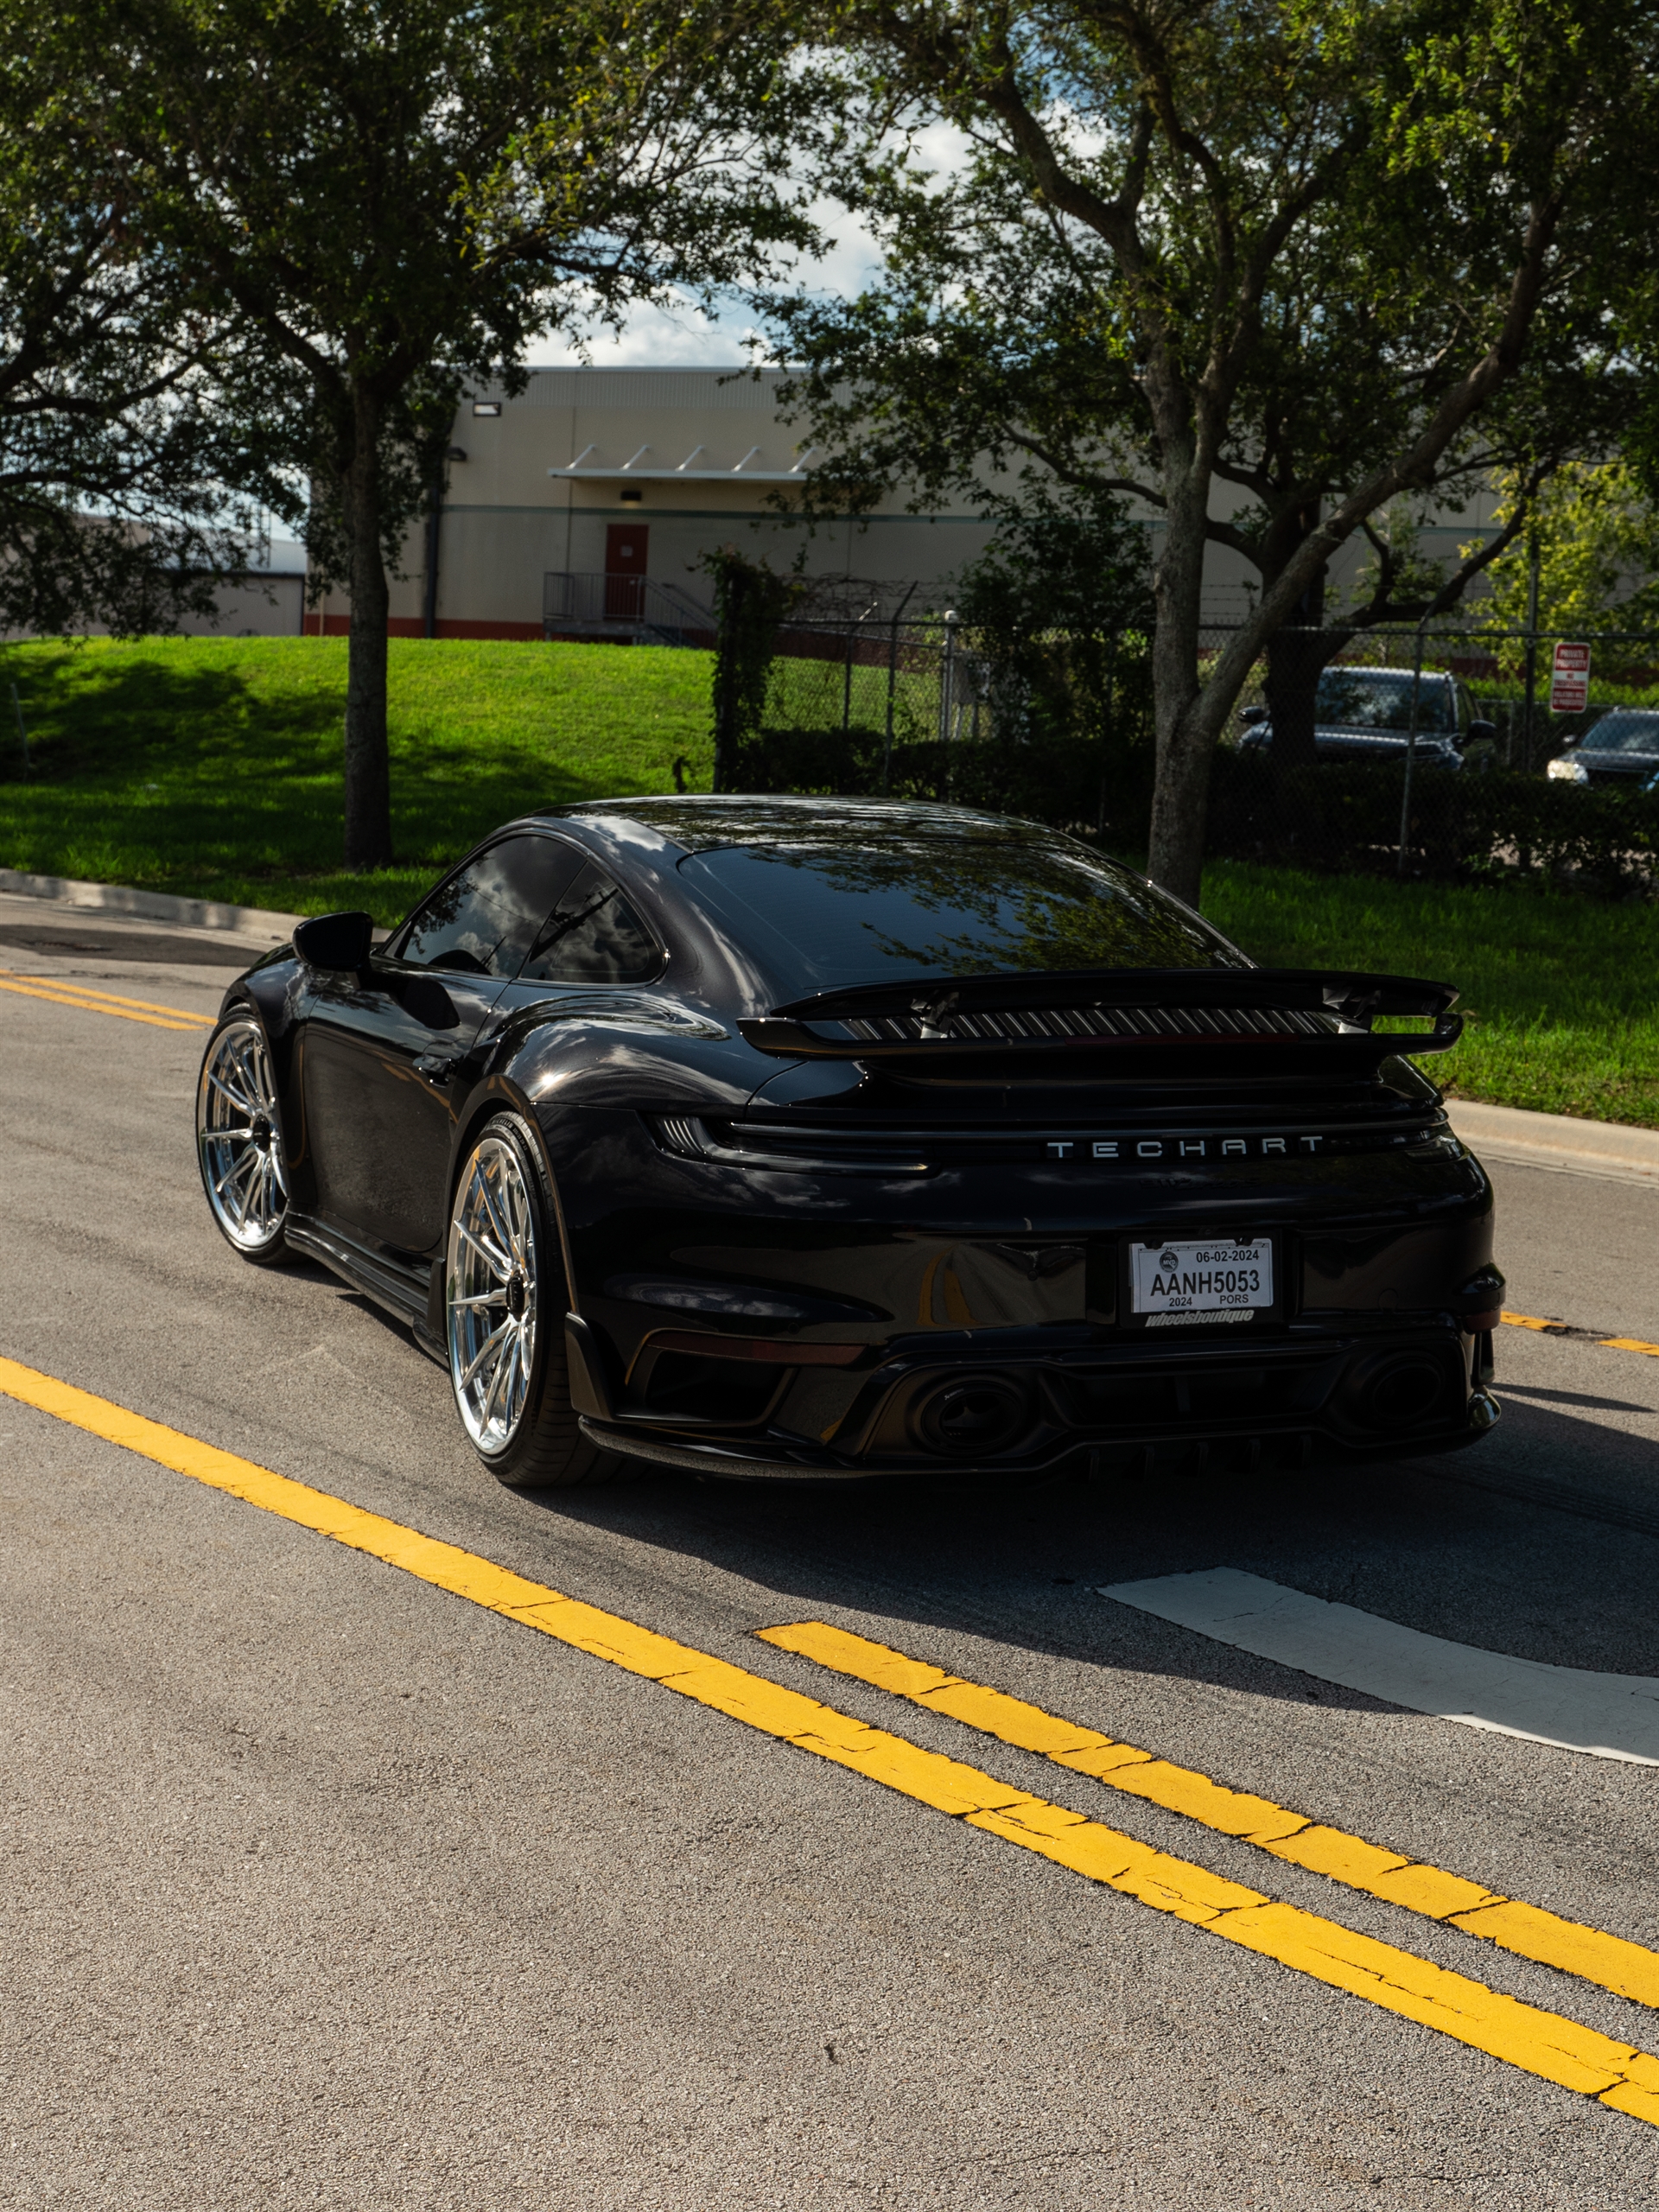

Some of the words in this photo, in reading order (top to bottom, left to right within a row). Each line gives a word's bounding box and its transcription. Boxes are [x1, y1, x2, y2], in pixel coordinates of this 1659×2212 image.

[1047, 1136, 1323, 1158] TECHART
[1196, 1249, 1259, 1262] 06-02-2024
[1150, 1269, 1260, 1296] AANH5053
[1169, 1297, 1192, 1306] 2024
[1219, 1294, 1249, 1304] PORS
[1145, 1309, 1255, 1327] wheelsboutique
